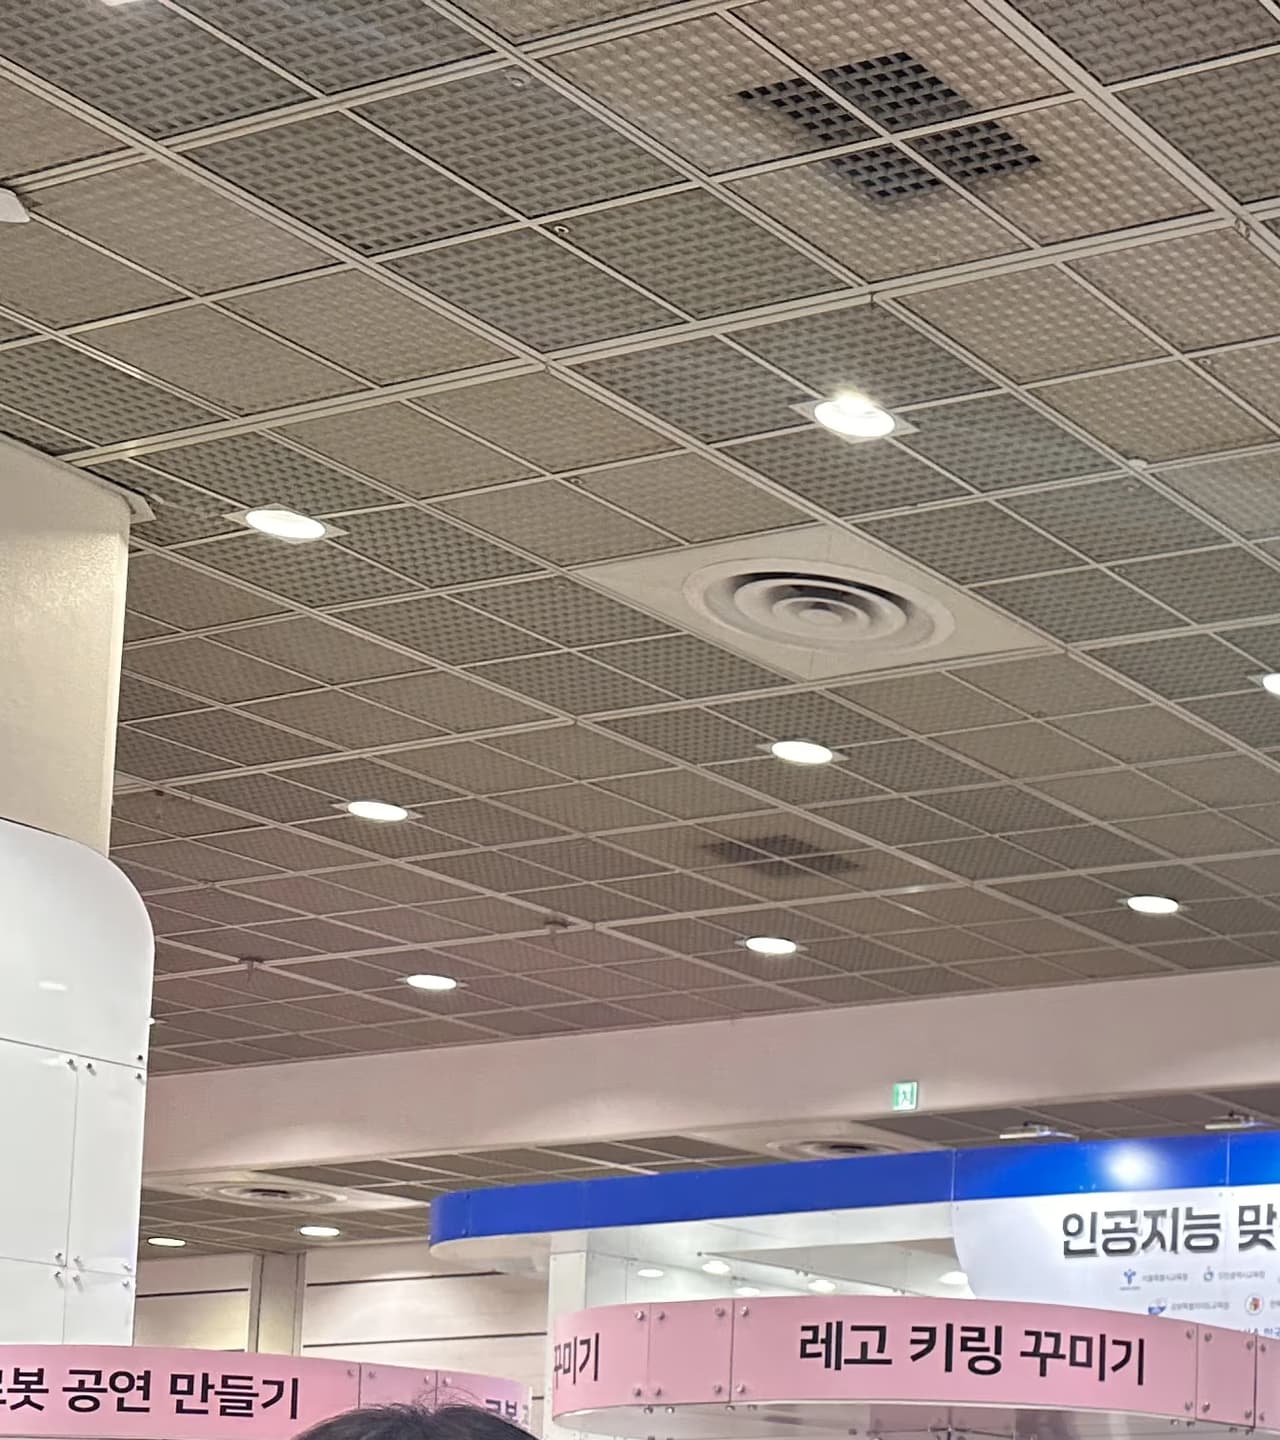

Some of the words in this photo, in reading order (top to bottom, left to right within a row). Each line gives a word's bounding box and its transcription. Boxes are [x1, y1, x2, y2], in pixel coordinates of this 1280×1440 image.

[1061, 1202, 1222, 1258] 인공지능
[800, 1320, 893, 1370] 레고
[910, 1323, 1004, 1376] 키링
[1020, 1329, 1146, 1385] 꾸미기
[0, 1367, 49, 1412] 봇
[62, 1369, 152, 1413] 공연
[169, 1372, 299, 1420] 만들기
